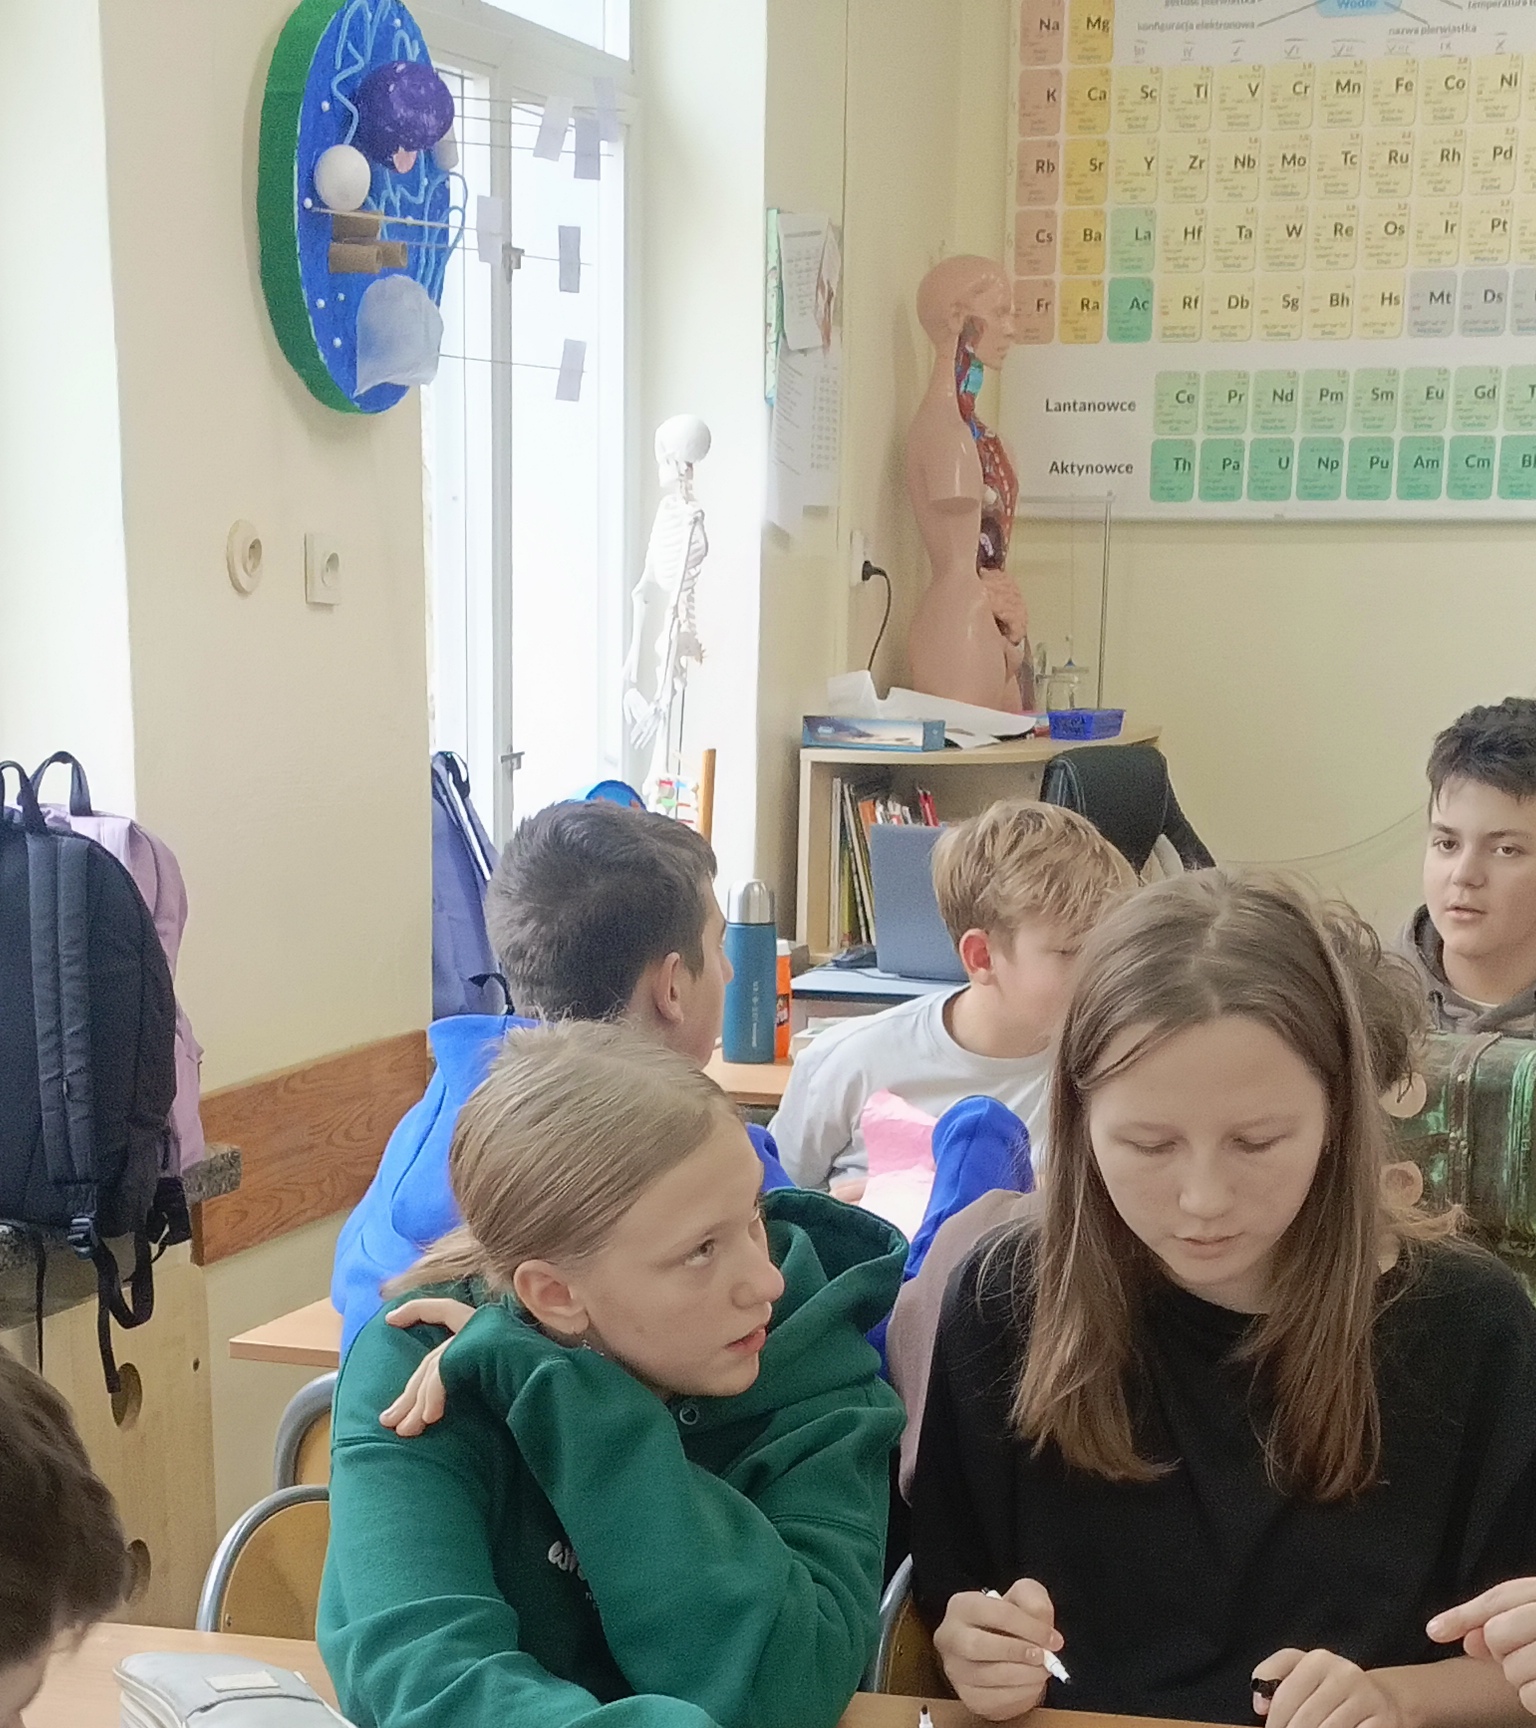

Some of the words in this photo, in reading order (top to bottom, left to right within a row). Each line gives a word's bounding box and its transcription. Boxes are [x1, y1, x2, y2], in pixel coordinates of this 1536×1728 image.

[1039, 17, 1060, 32] Na
[1086, 17, 1110, 33] Mg
[1292, 81, 1310, 95] Cr
[1336, 79, 1362, 94] Mn
[1395, 77, 1413, 92] Fe
[1444, 75, 1466, 90] Co
[1047, 88, 1057, 102] K
[1087, 87, 1107, 101] Ca
[1140, 85, 1157, 99] Sc
[1248, 83, 1260, 97] V
[1342, 151, 1358, 165] Tc
[1388, 150, 1409, 164] Ru
[1440, 148, 1461, 163] Rh
[1493, 146, 1512, 161] Pd
[1035, 159, 1055, 173] Rb
[1089, 158, 1104, 173] Sr
[1144, 156, 1155, 170] Y
[1189, 155, 1205, 170] Zr
[1234, 155, 1256, 170] Nb
[1281, 154, 1307, 168] Mo
[1237, 225, 1253, 240] Ta
[1286, 224, 1302, 238] W
[1334, 222, 1353, 237] Re
[1384, 221, 1405, 236] Os
[1444, 219, 1457, 234] Ir
[1491, 218, 1508, 233] Pt
[1035, 228, 1053, 243] Cs
[1083, 228, 1102, 242] Ba
[1134, 228, 1152, 241] La
[1184, 226, 1202, 240] Hf
[1183, 295, 1201, 309] Rf
[1228, 295, 1249, 309] Db
[1282, 294, 1300, 311] Sg
[1330, 293, 1350, 308] Bh
[1381, 292, 1400, 306] Hs
[1429, 291, 1452, 306] Mt
[1483, 289, 1503, 304] Ds
[1036, 298, 1051, 312] Fr
[1081, 298, 1100, 311] Ra
[1129, 297, 1150, 311] Ac
[1176, 390, 1195, 404] Ce
[1227, 390, 1244, 404] Pr
[1272, 389, 1294, 403] Nd
[1319, 388, 1344, 402] Pm
[1371, 387, 1394, 401] Sm
[1426, 385, 1444, 400] Eu
[1474, 384, 1497, 399] Gd
[1045, 398, 1137, 413] Lantanowce
[1048, 460, 1134, 477] Aktynowce
[1173, 458, 1191, 472] Th
[1222, 458, 1240, 471] Pa
[1278, 457, 1289, 470] U
[1318, 457, 1339, 473] Np
[1370, 456, 1389, 470] Pu
[1414, 456, 1439, 469] Am
[1465, 455, 1490, 469] Cm
